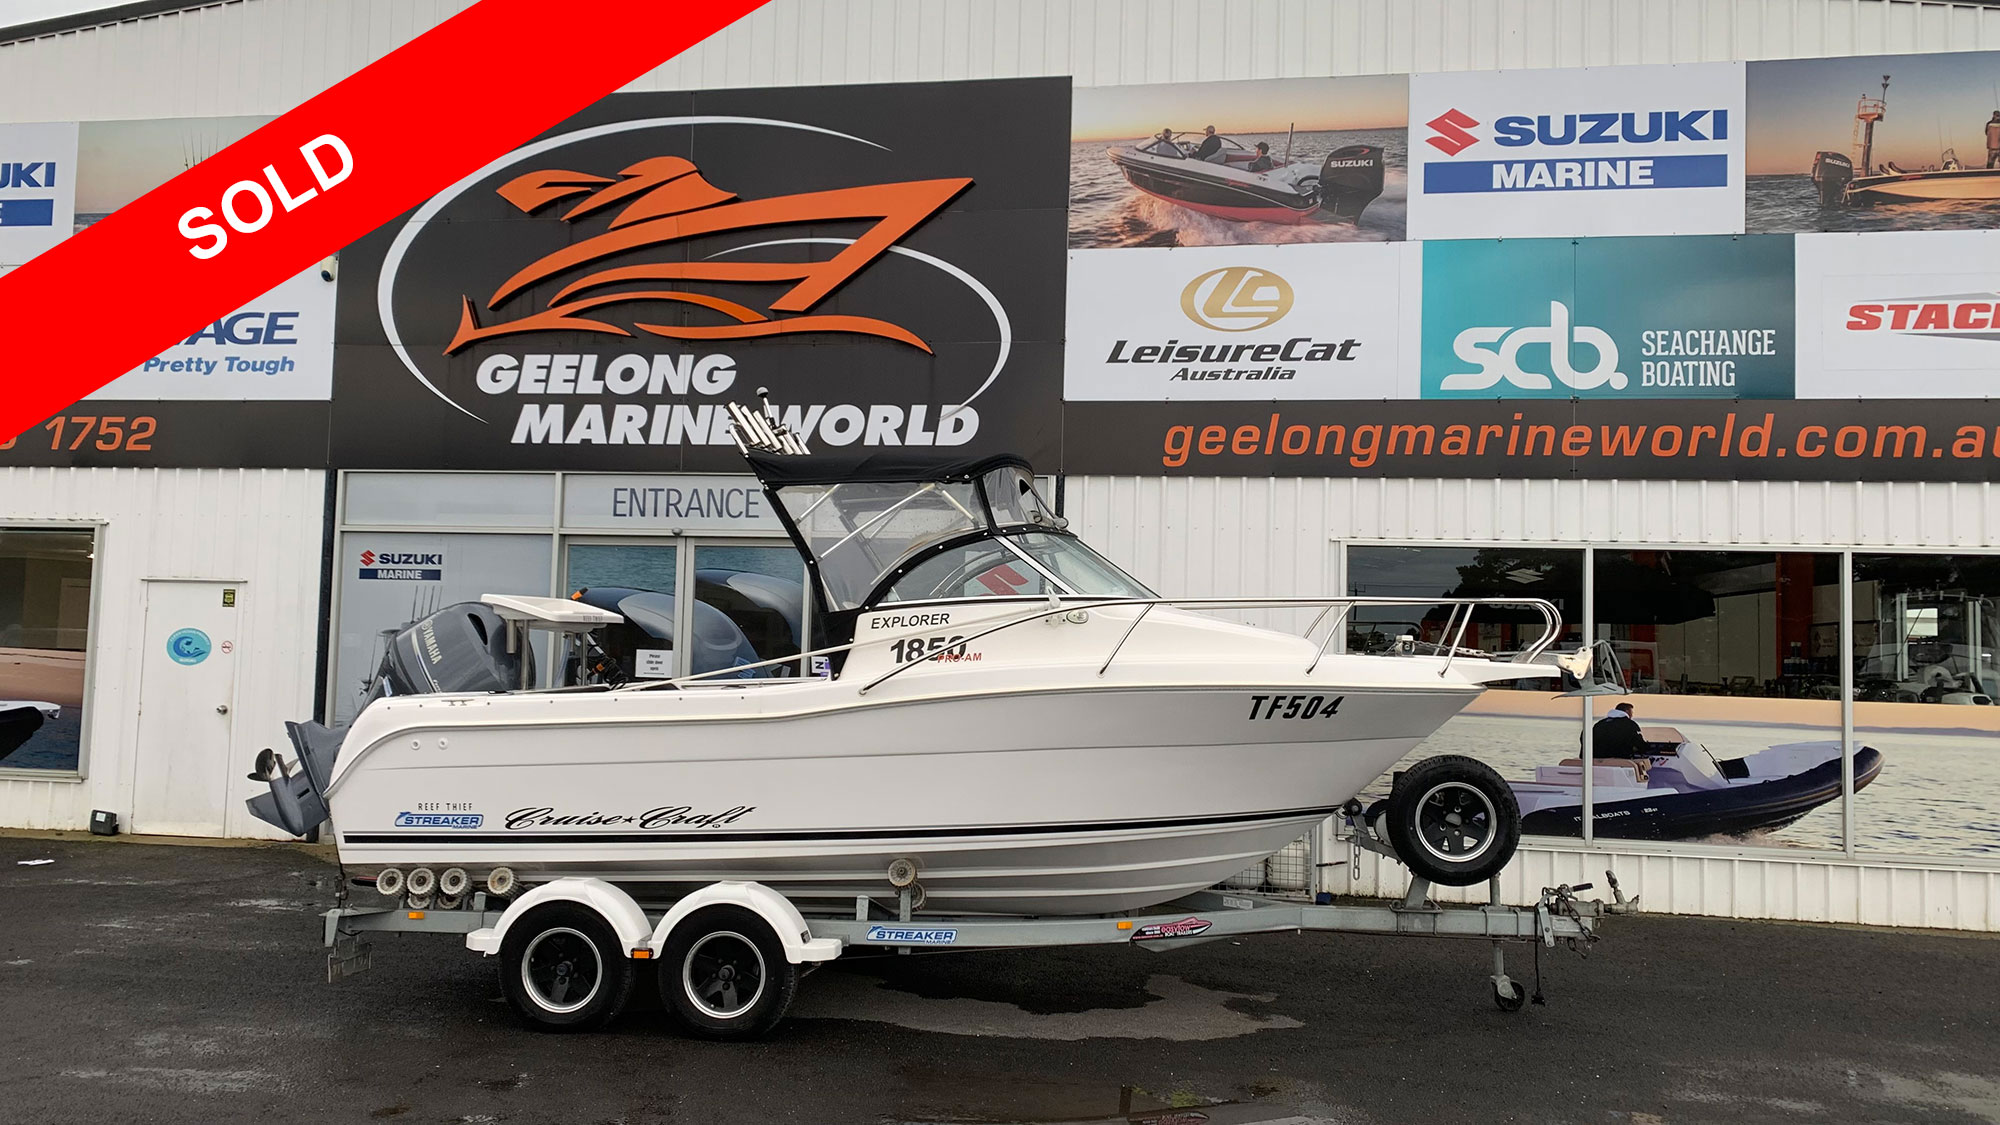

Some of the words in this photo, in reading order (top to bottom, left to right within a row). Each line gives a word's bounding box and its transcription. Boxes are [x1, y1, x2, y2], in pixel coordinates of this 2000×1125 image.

[1493, 109, 1728, 147] SUZUKI
[1330, 159, 1374, 168] SUZUKI
[1492, 160, 1654, 189] MARINE
[174, 312, 300, 346] AGE
[1846, 303, 2000, 331] STAC
[1105, 337, 1362, 364] LeisureCat
[1641, 329, 1776, 356] SEACHANGE
[143, 356, 218, 376] Pretty
[225, 356, 295, 376] Tough
[476, 353, 737, 396] GEELONG
[1169, 366, 1297, 382] Australia
[1641, 361, 1736, 387] BOATING
[45, 416, 157, 451] 1752
[1162, 413, 2000, 468] geelongmarineworld.com.a
[612, 488, 761, 518] ENTRANCE
[378, 553, 443, 565] SUZUKI
[377, 569, 423, 580] MARINE
[871, 613, 950, 629] EXPLORER
[422, 626, 443, 665] YAMAHA
[890, 635, 967, 664] 1850
[1249, 695, 1344, 720] TF504
[418, 802, 440, 811] REEF
[446, 802, 473, 811] THIEF
[505, 806, 624, 830] Cruise
[638, 805, 757, 830] Craft
[404, 816, 480, 825] STREAKER
[876, 931, 954, 940] STREAKER
